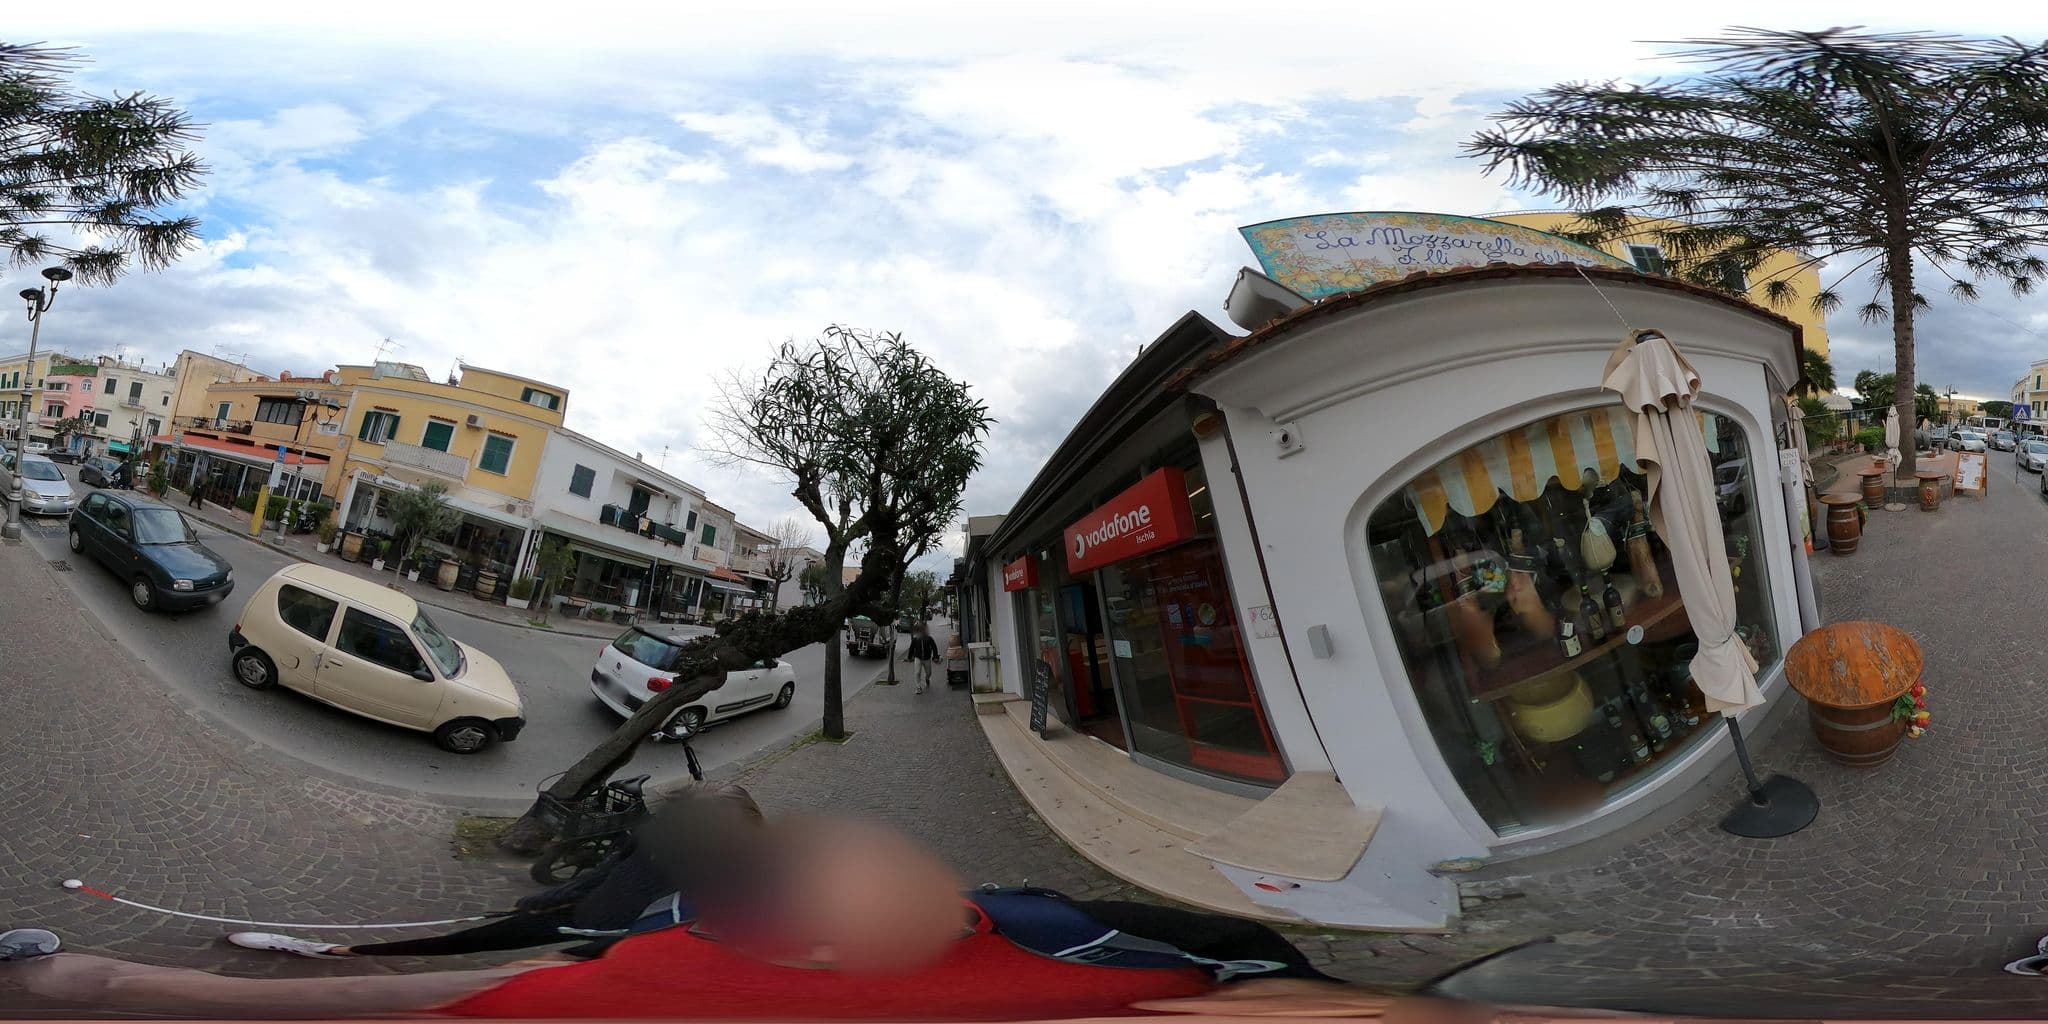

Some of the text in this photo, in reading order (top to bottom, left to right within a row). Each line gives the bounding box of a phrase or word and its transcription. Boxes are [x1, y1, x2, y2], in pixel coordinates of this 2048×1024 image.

[1304, 230, 1360, 250] La
[1366, 227, 1528, 258] Mozzarella
[1086, 505, 1151, 548] vodafone
[1136, 531, 1155, 544] Ischia
